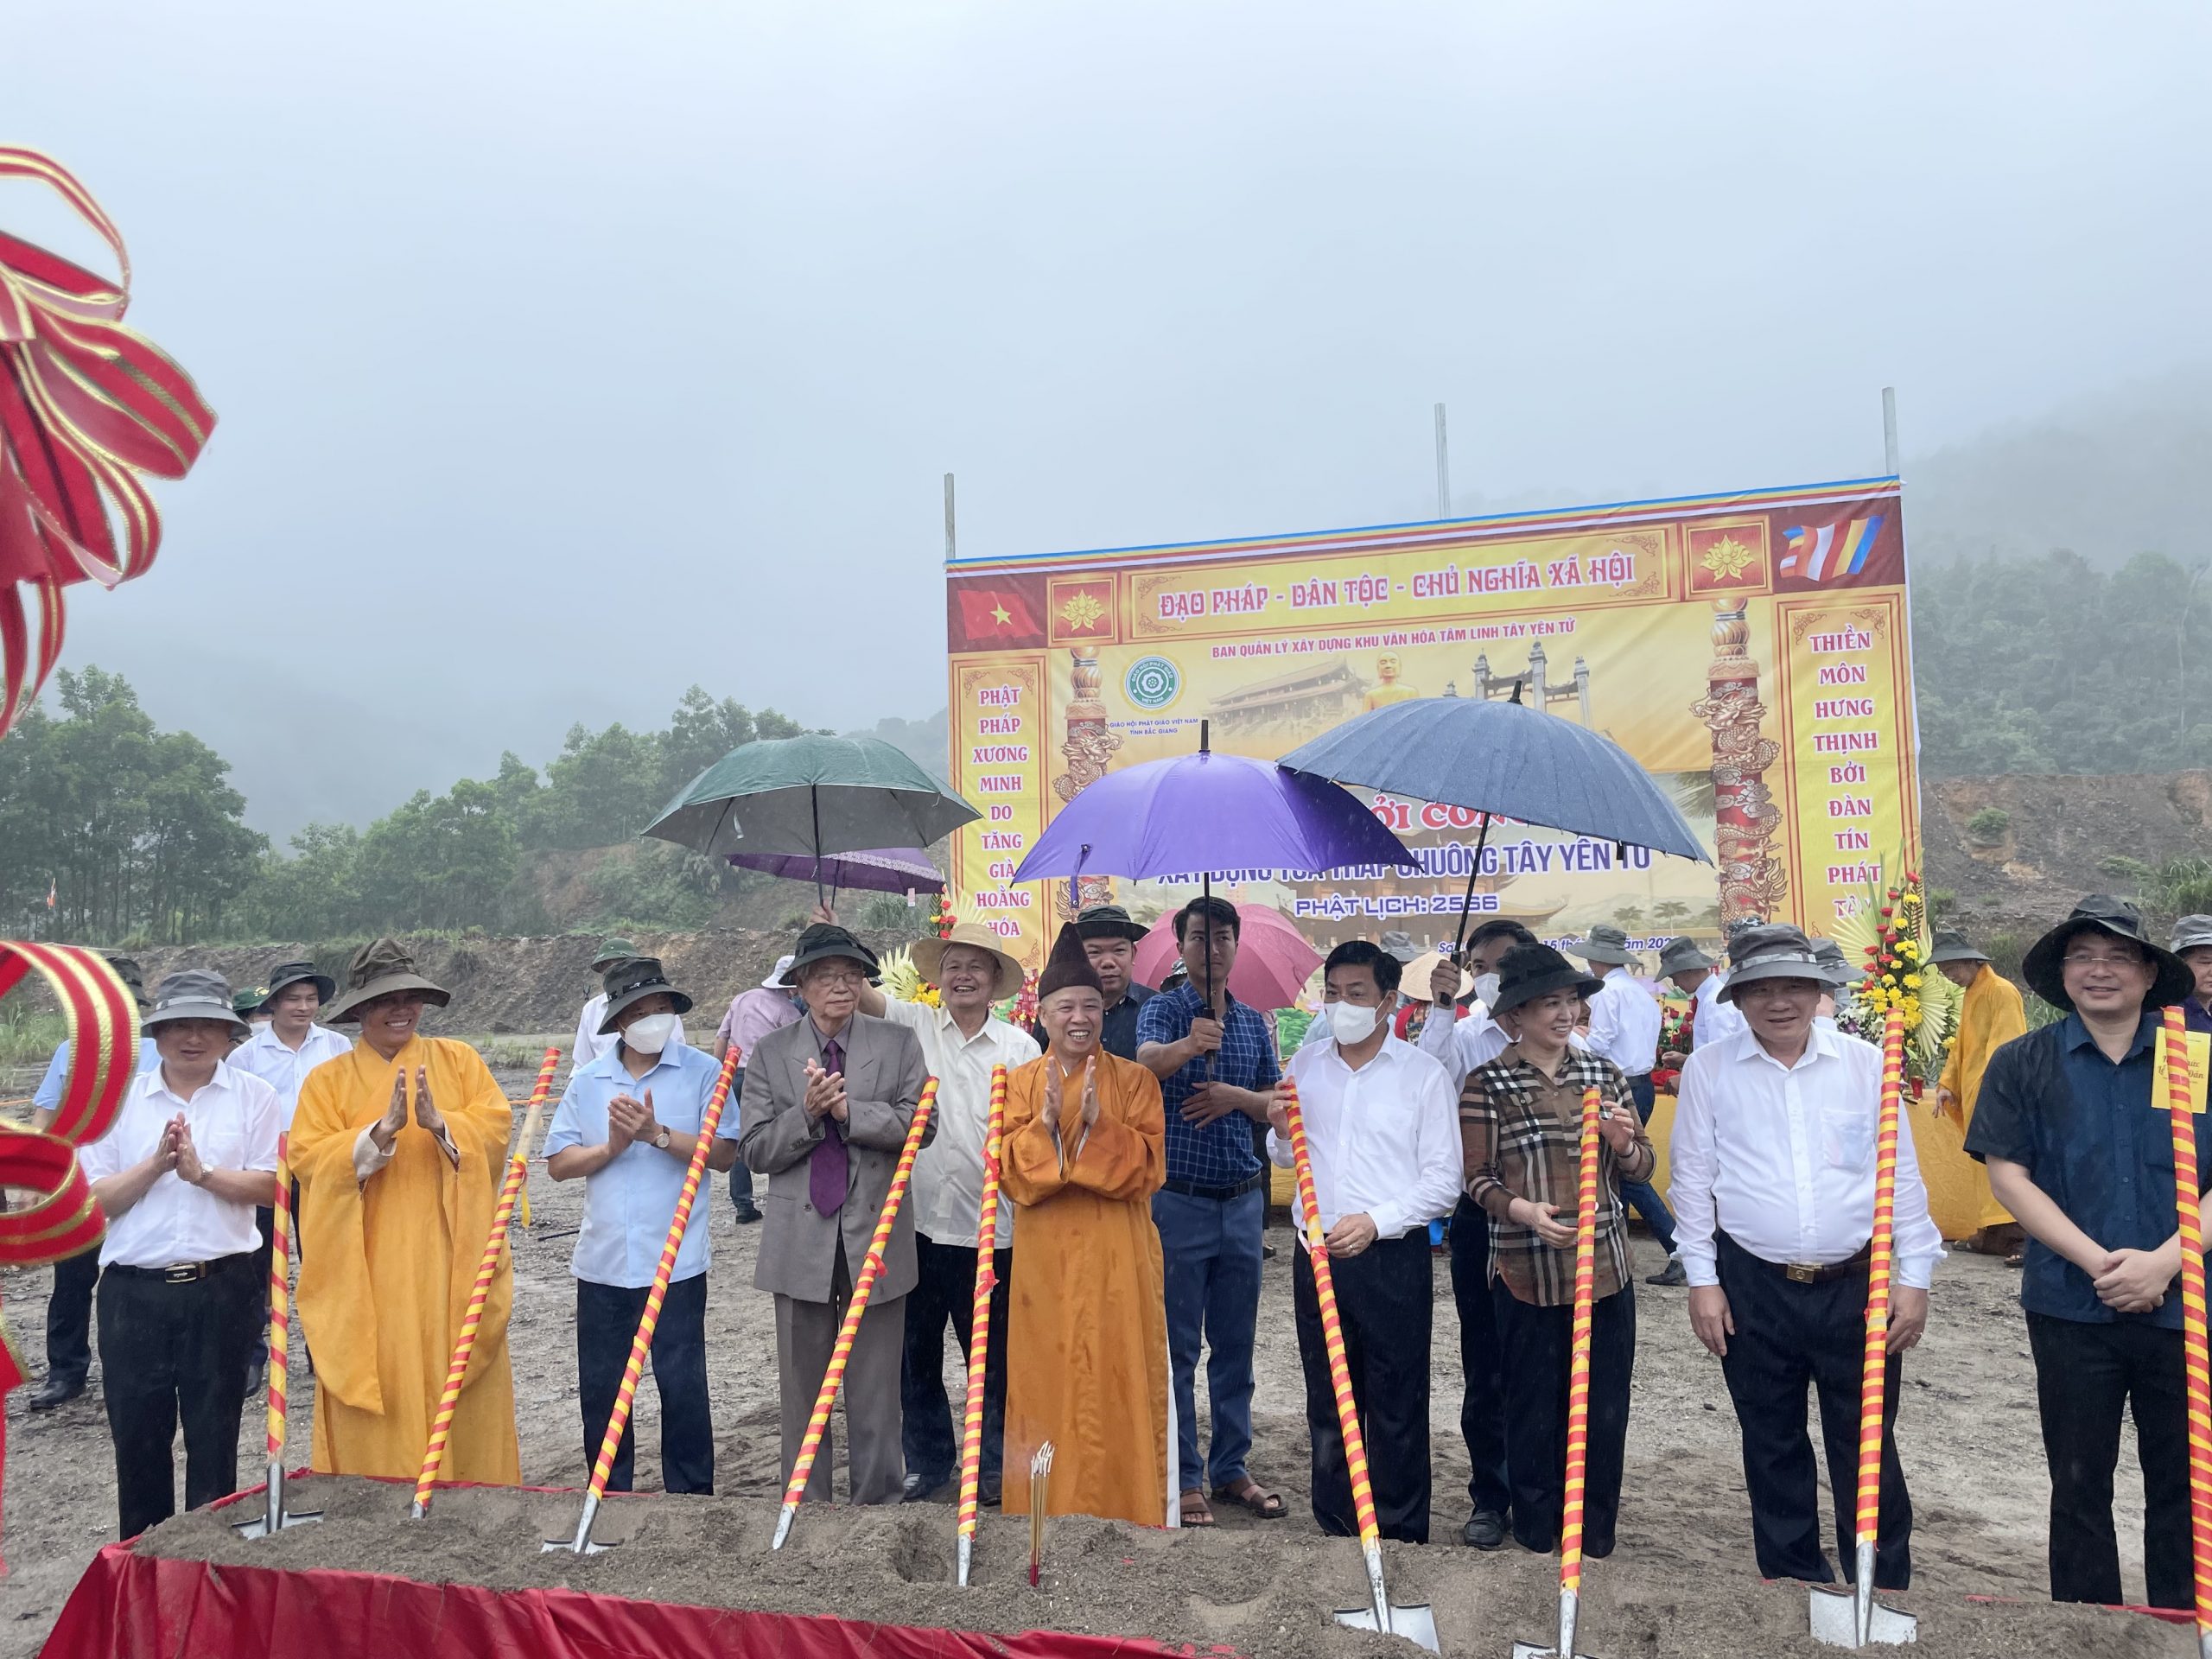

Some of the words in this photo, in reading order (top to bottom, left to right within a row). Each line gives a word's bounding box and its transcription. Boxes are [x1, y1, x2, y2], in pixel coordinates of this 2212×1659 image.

[1160, 592, 1205, 621] ĐẠO
[1212, 582, 1268, 613] PHÁP
[1292, 577, 1338, 607] DÂN
[1344, 574, 1389, 607] TỘC
[1413, 565, 1460, 598] CHỦ
[1468, 561, 1541, 593] NGHĨA
[1548, 555, 1582, 587] XÃ
[1589, 552, 1633, 588] HỘI
[1212, 645, 1236, 658] BAN
[1240, 640, 1271, 656] QUẢN
[1275, 639, 1288, 653] LÝ
[1292, 639, 1315, 652] XÂY
[1319, 638, 1351, 652] DỰNG
[1355, 635, 1379, 648] KHU
[1382, 632, 1407, 645] VĂN
[1411, 631, 1436, 644] HÓA
[1440, 627, 1466, 641] TÂM
[1471, 626, 1499, 639] LINH
[1503, 622, 1526, 637] TÂY
[1529, 620, 1554, 634] YÊN
[1558, 617, 1576, 632] TỬ
[1809, 625, 1871, 652] THIỀN
[1820, 662, 1866, 684] MÔN
[980, 685, 1020, 708] PHẬT
[1815, 699, 1873, 718] HƯNG
[979, 714, 1021, 734] PHÁP
[1813, 732, 1878, 754] THỊNH
[973, 746, 1028, 763] XƯƠNG
[980, 776, 1022, 791] MINH
[1830, 761, 1866, 784] BỞI
[990, 805, 1013, 820] DO
[1828, 795, 1872, 817] ĐÀN
[982, 831, 1022, 849] TĂNG
[1834, 828, 1869, 849] TÍN
[1503, 841, 1553, 873] TÂY
[1557, 838, 1611, 871] YÊN
[989, 859, 1015, 878] GIÀ
[1827, 861, 1881, 883] PHÁT
[976, 885, 1030, 907] HOẰNG
[1296, 895, 1359, 919] PHẬT
[1363, 898, 1427, 918] LỊCH:
